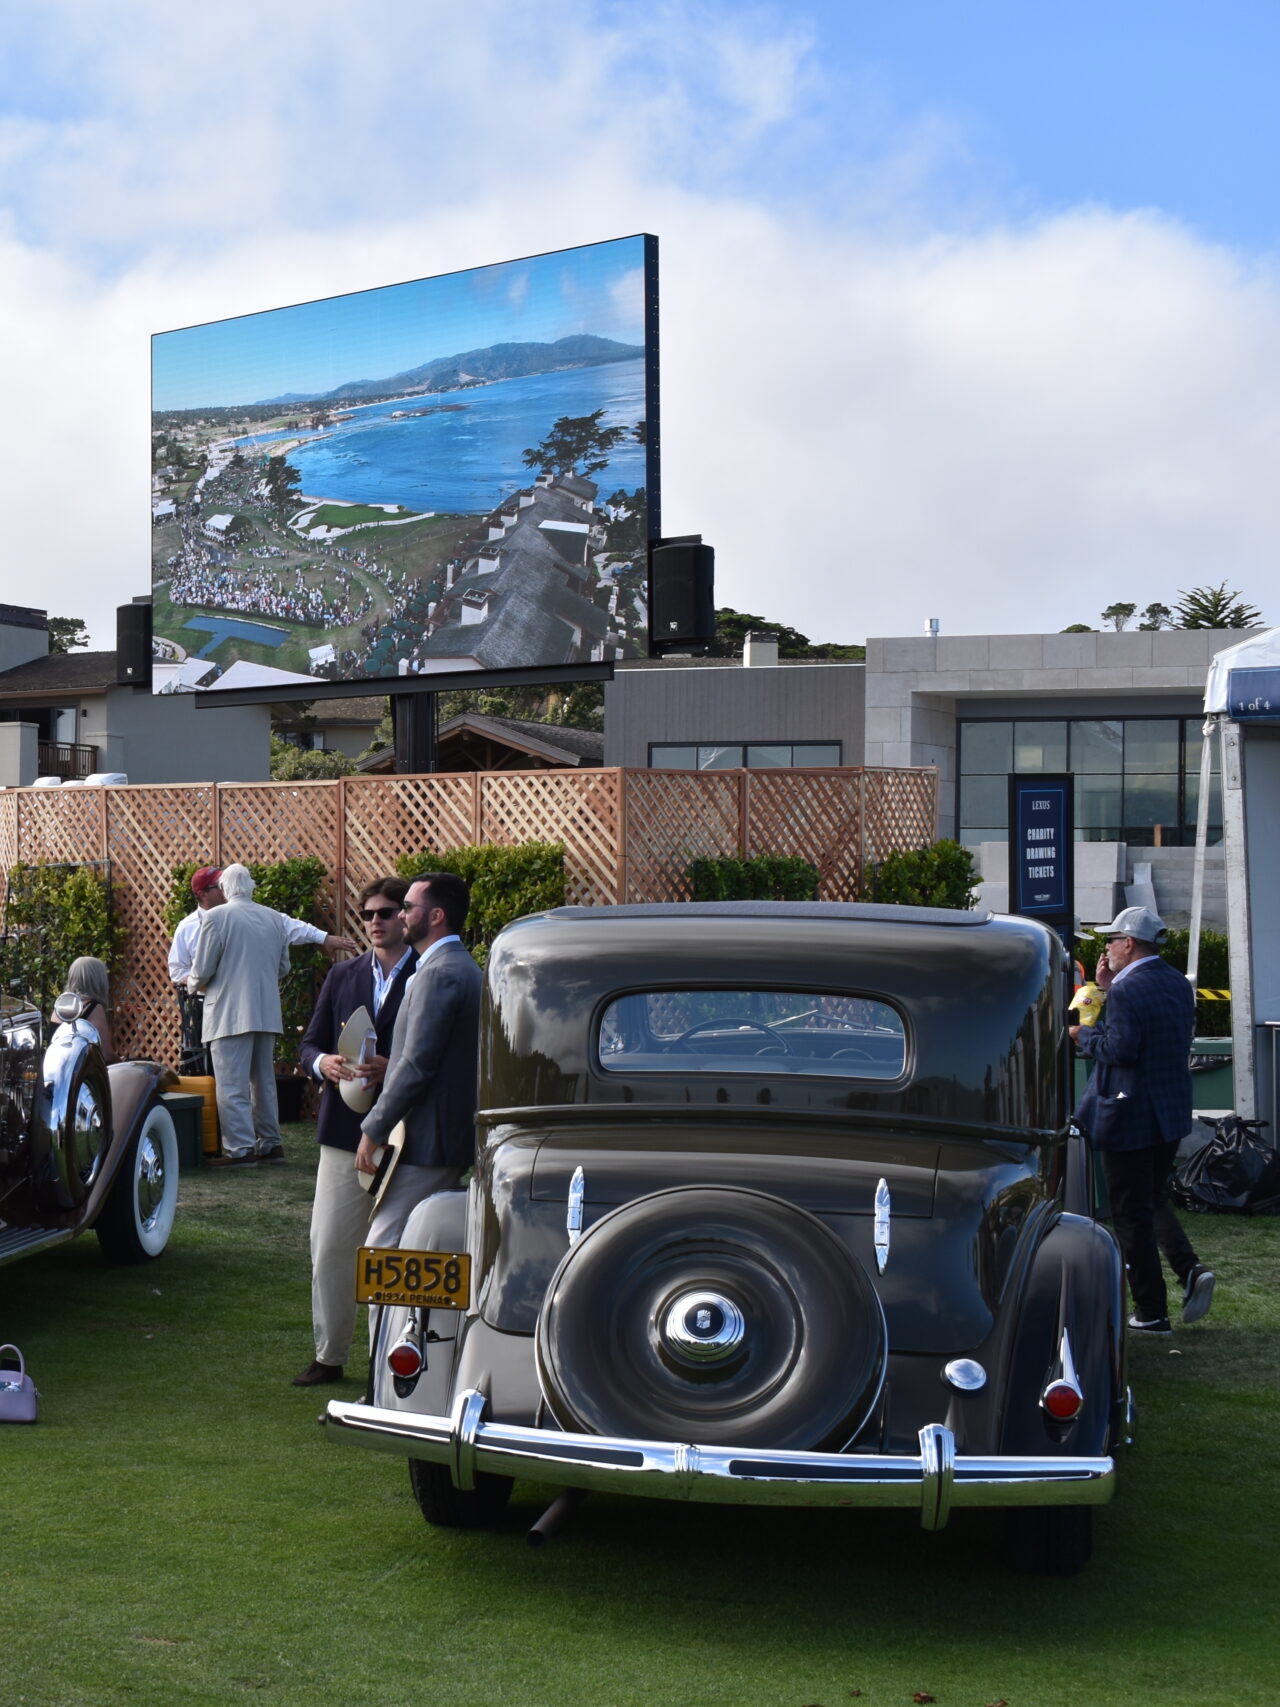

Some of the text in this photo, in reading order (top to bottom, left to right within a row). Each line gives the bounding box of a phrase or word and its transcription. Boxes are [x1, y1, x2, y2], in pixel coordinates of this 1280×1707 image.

[1238, 696, 1271, 711] 1 of 4
[1031, 800, 1051, 811] LEXUS
[1027, 827, 1055, 841] CHARITY
[1026, 846, 1056, 860] DRAWING
[1028, 865, 1055, 879] TICKETS
[364, 1255, 461, 1294] H5858
[409, 1293, 442, 1305] PENNA
